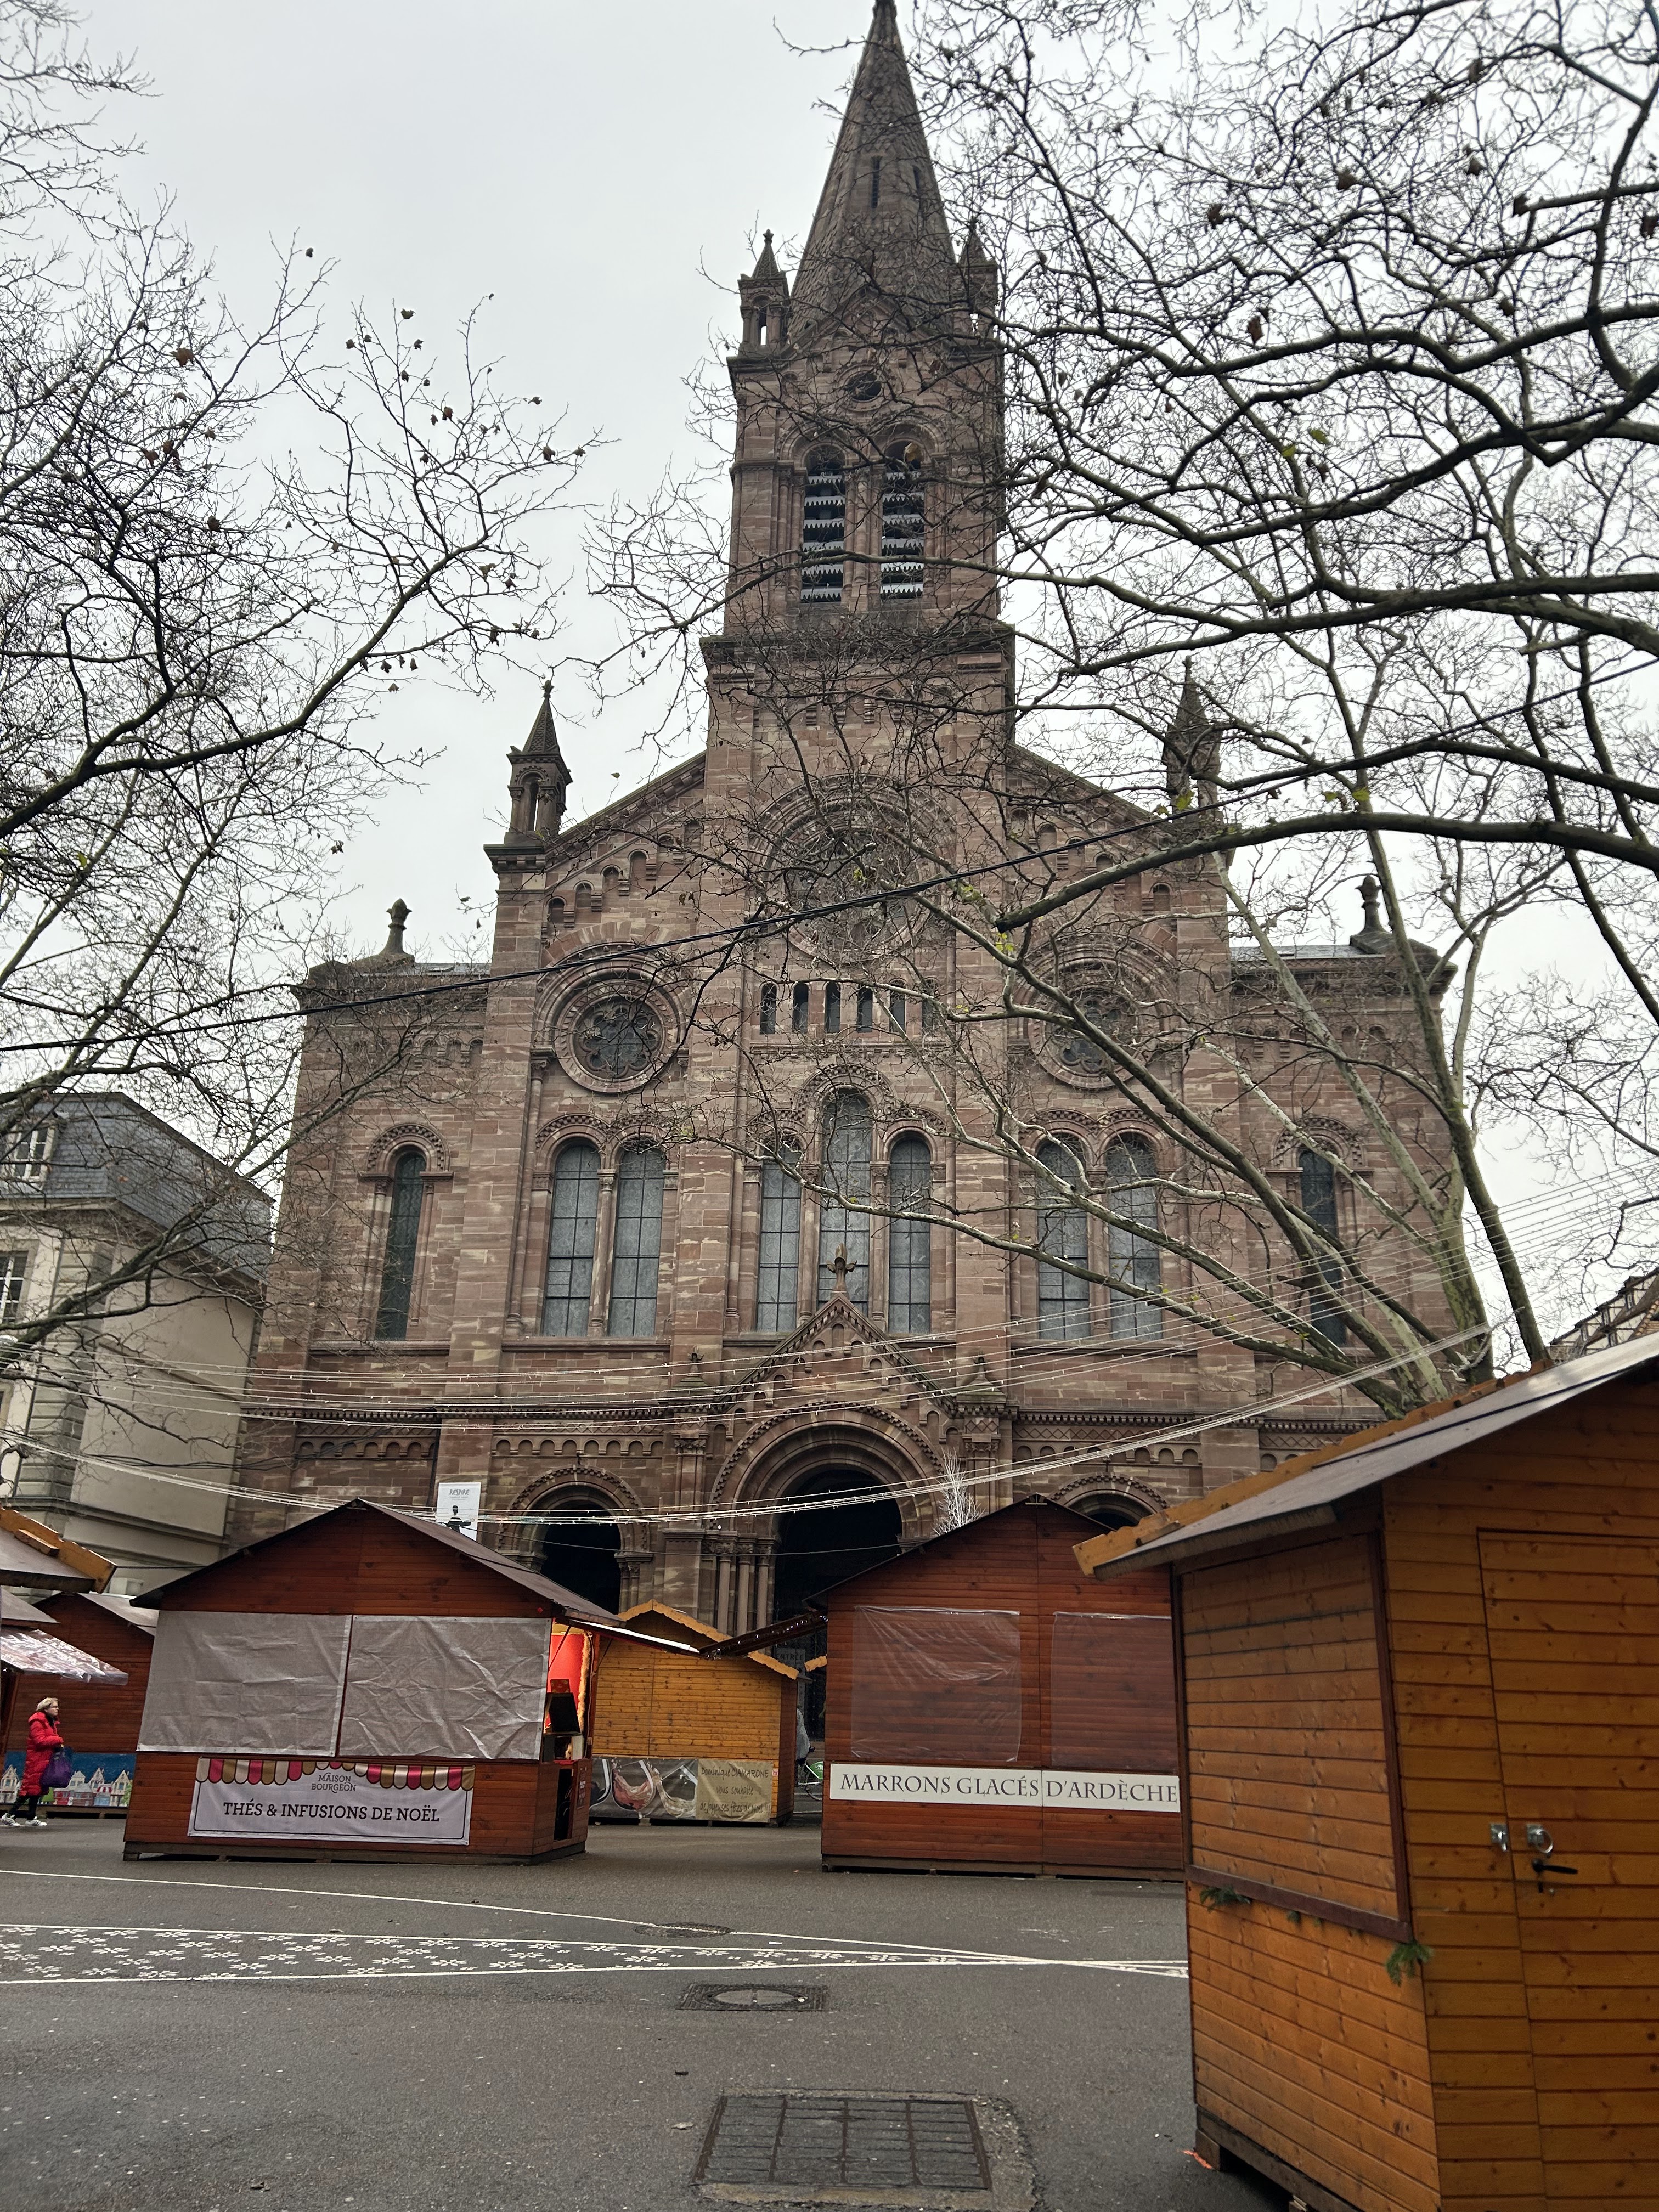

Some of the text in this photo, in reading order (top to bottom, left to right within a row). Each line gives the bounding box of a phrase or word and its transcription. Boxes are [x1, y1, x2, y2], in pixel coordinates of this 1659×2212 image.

[318, 1772, 351, 1782] MAISON
[701, 1766, 769, 1780] Dominique CIAMARONE
[311, 1781, 357, 1793] BOURGEON
[731, 1785, 754, 1796] souhaite
[840, 1774, 1177, 1803] MARRONS GLACÉS D'ARDÈCHE
[223, 1798, 439, 1822] THÉS & INFUSIONS DE NOËL
